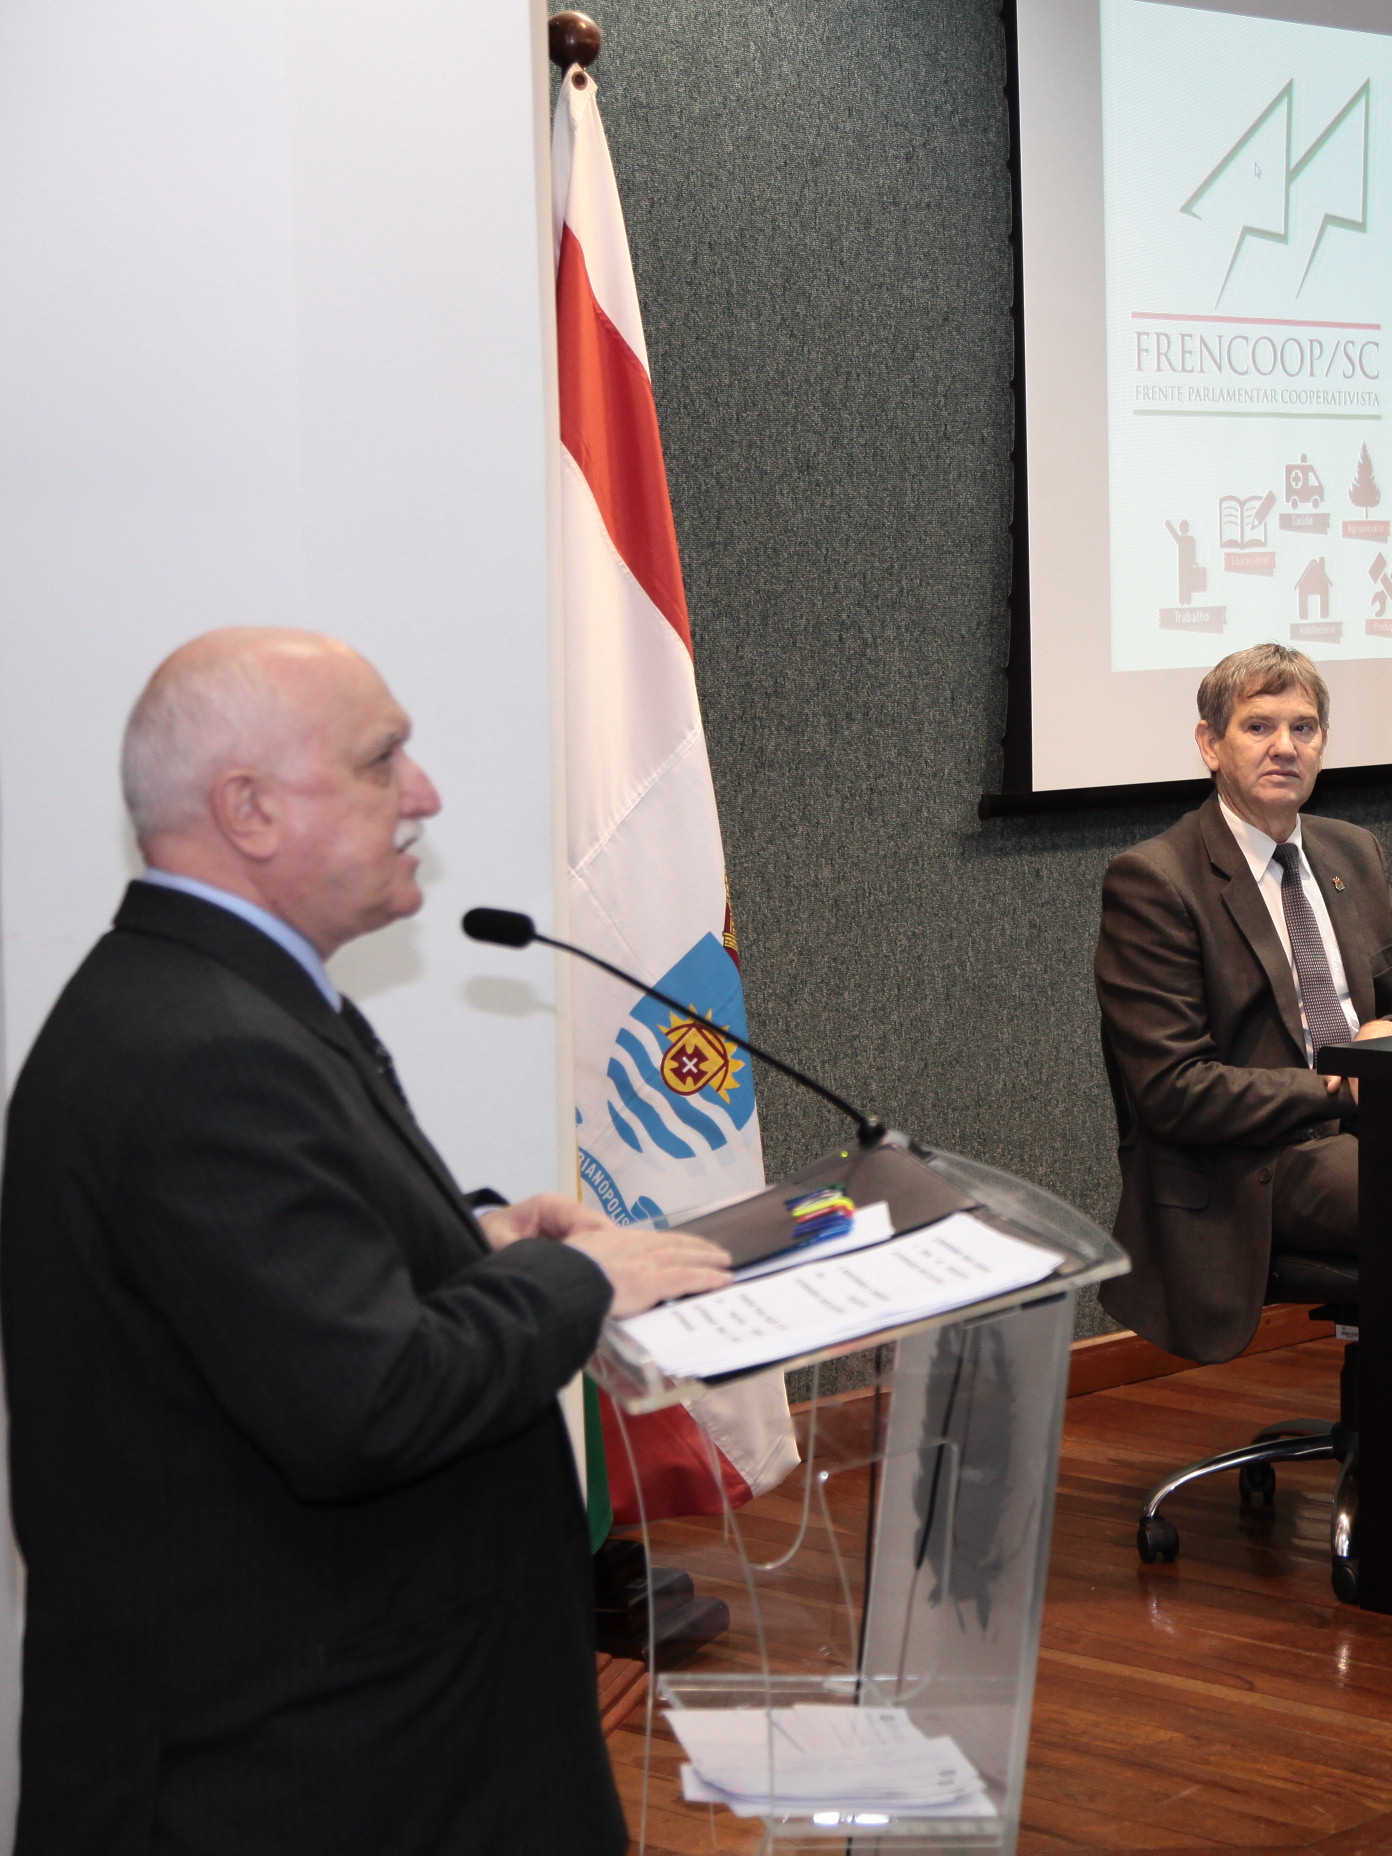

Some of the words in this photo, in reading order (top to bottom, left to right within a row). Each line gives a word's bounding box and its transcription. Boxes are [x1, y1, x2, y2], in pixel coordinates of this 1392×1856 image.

[1134, 331, 1380, 380] FRENCOOP/SC
[1135, 385, 1183, 401] FRENTE
[1188, 387, 1277, 405] PARLAMENTAR
[1281, 389, 1380, 407] COOPERATIVISTA
[1174, 610, 1210, 624] Trabalho
